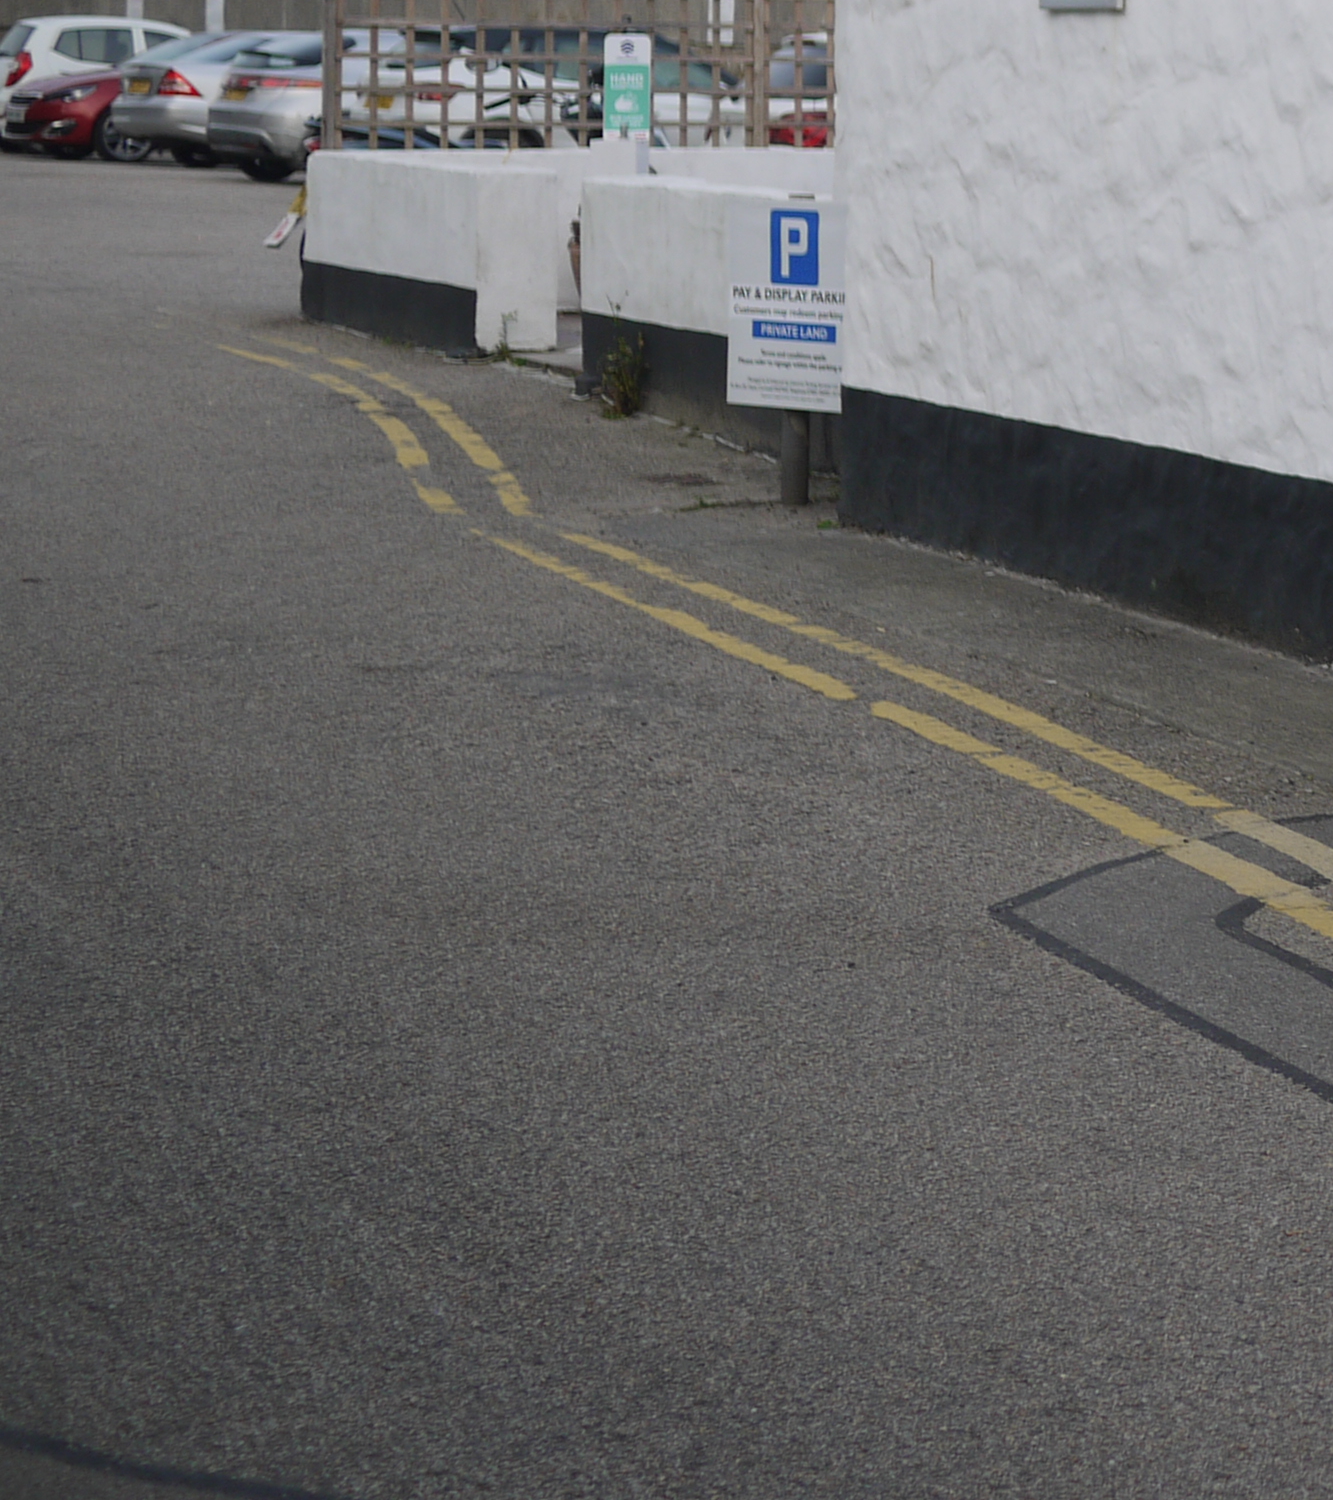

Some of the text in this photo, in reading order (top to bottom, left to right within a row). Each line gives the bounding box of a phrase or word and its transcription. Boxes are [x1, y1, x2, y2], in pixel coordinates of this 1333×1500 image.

[780, 216, 809, 278] P
[733, 285, 751, 299] PAY
[754, 286, 761, 300] &
[764, 287, 806, 304] DISPLAY
[760, 323, 828, 341] PRIVATE LAND
